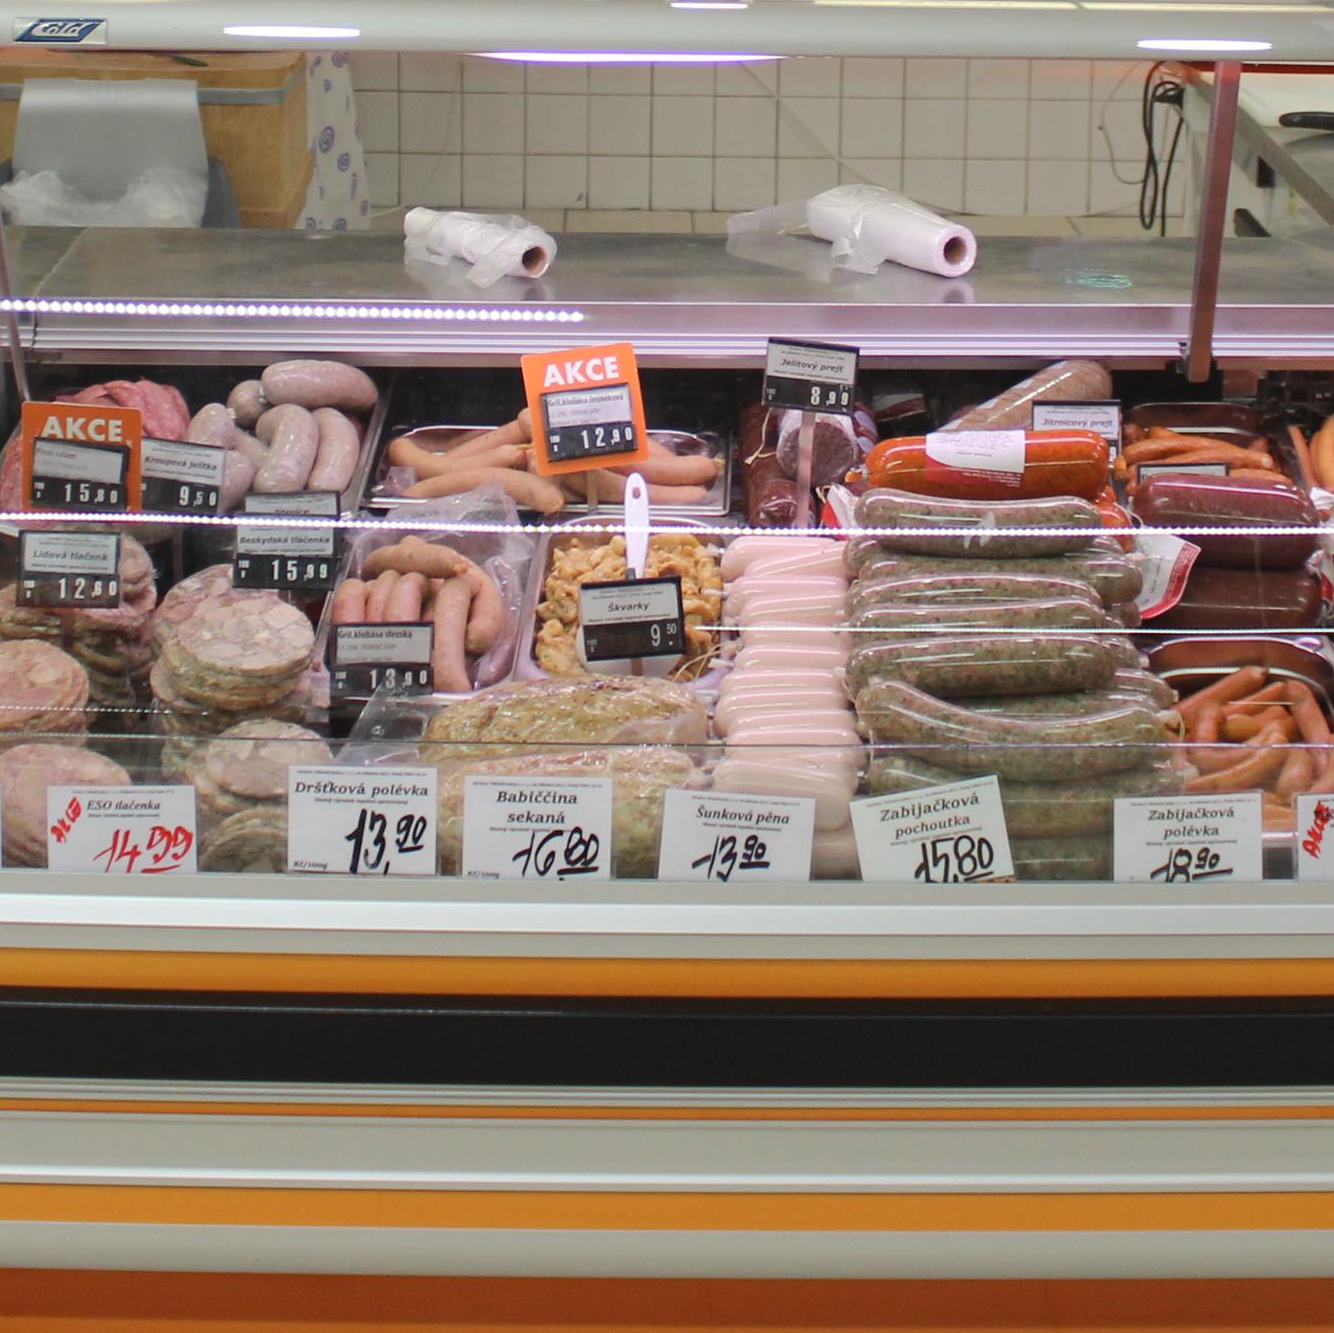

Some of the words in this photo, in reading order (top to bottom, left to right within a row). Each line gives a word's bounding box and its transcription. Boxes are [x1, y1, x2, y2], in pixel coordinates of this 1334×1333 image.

[543, 357, 619, 387] AKCE
[43, 416, 123, 443] AKCE
[607, 601, 650, 614] Škvarky
[295, 780, 365, 795] Dršťková
[371, 783, 428, 798] polévka
[497, 790, 578, 805] Babiččina
[86, 800, 112, 811] ESO
[115, 799, 161, 811] tlačenka
[879, 792, 980, 822] Zabijačková
[508, 811, 565, 825] sekaná
[695, 805, 753, 822] Šunková
[755, 811, 790, 825] pěna
[1147, 806, 1235, 822] Zabijačková
[895, 815, 971, 840] pochoutka
[1163, 825, 1220, 840] polévka
